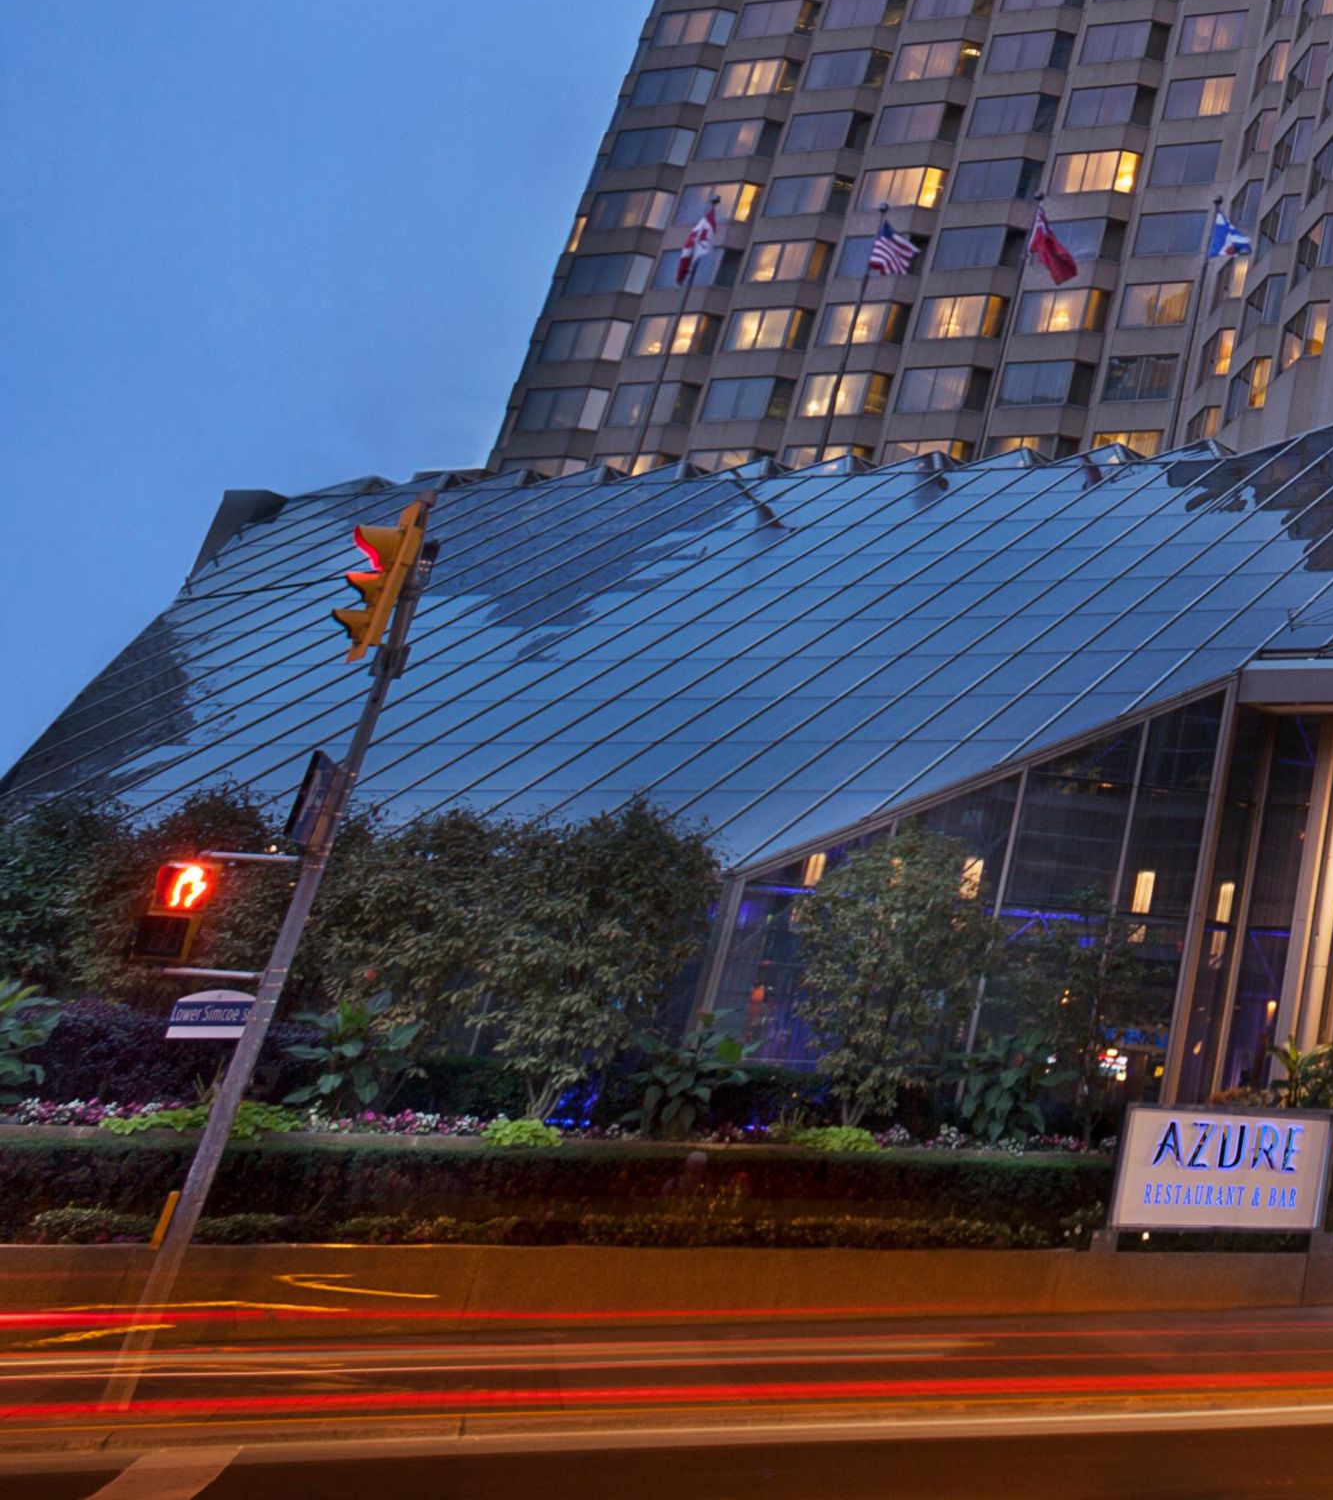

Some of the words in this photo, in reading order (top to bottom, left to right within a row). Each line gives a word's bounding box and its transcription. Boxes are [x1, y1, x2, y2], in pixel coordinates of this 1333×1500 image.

[170, 1005, 203, 1022] Lower
[201, 1004, 241, 1022] Simcoe
[1152, 1120, 1304, 1172] AZURE
[1143, 1183, 1246, 1207] RESTAURANT
[1251, 1186, 1262, 1208] &
[1268, 1187, 1299, 1209] BAR
